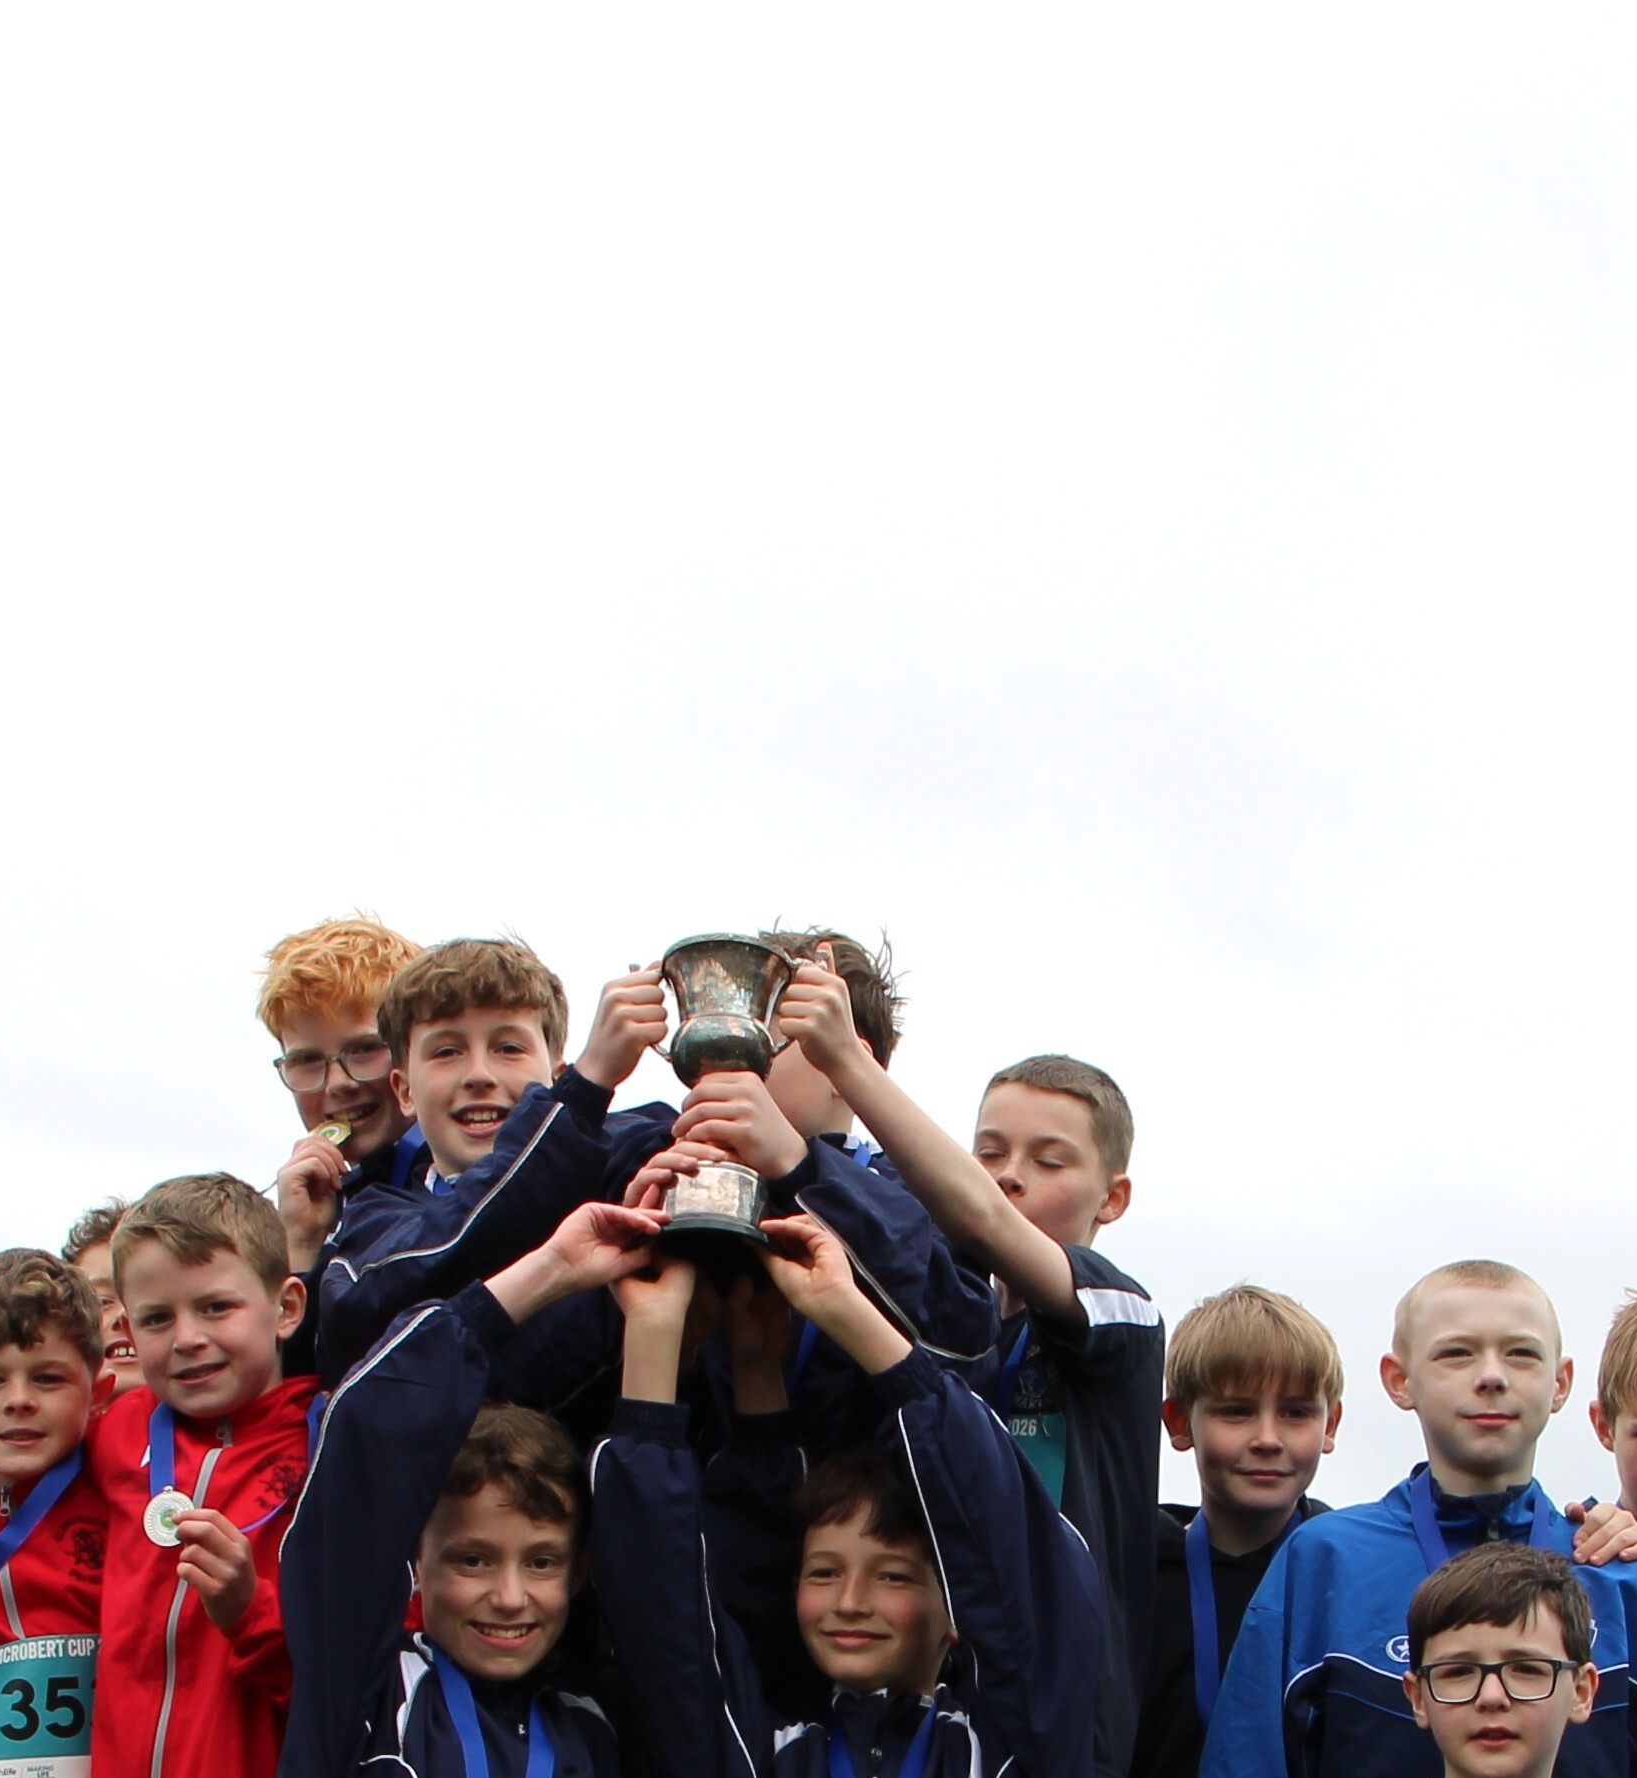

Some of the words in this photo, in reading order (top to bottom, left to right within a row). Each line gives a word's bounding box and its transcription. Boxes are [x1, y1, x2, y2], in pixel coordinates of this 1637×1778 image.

[1009, 1418, 1037, 1437] 026
[67, 1638, 95, 1658] CUP
[0, 1677, 96, 1742] 35
